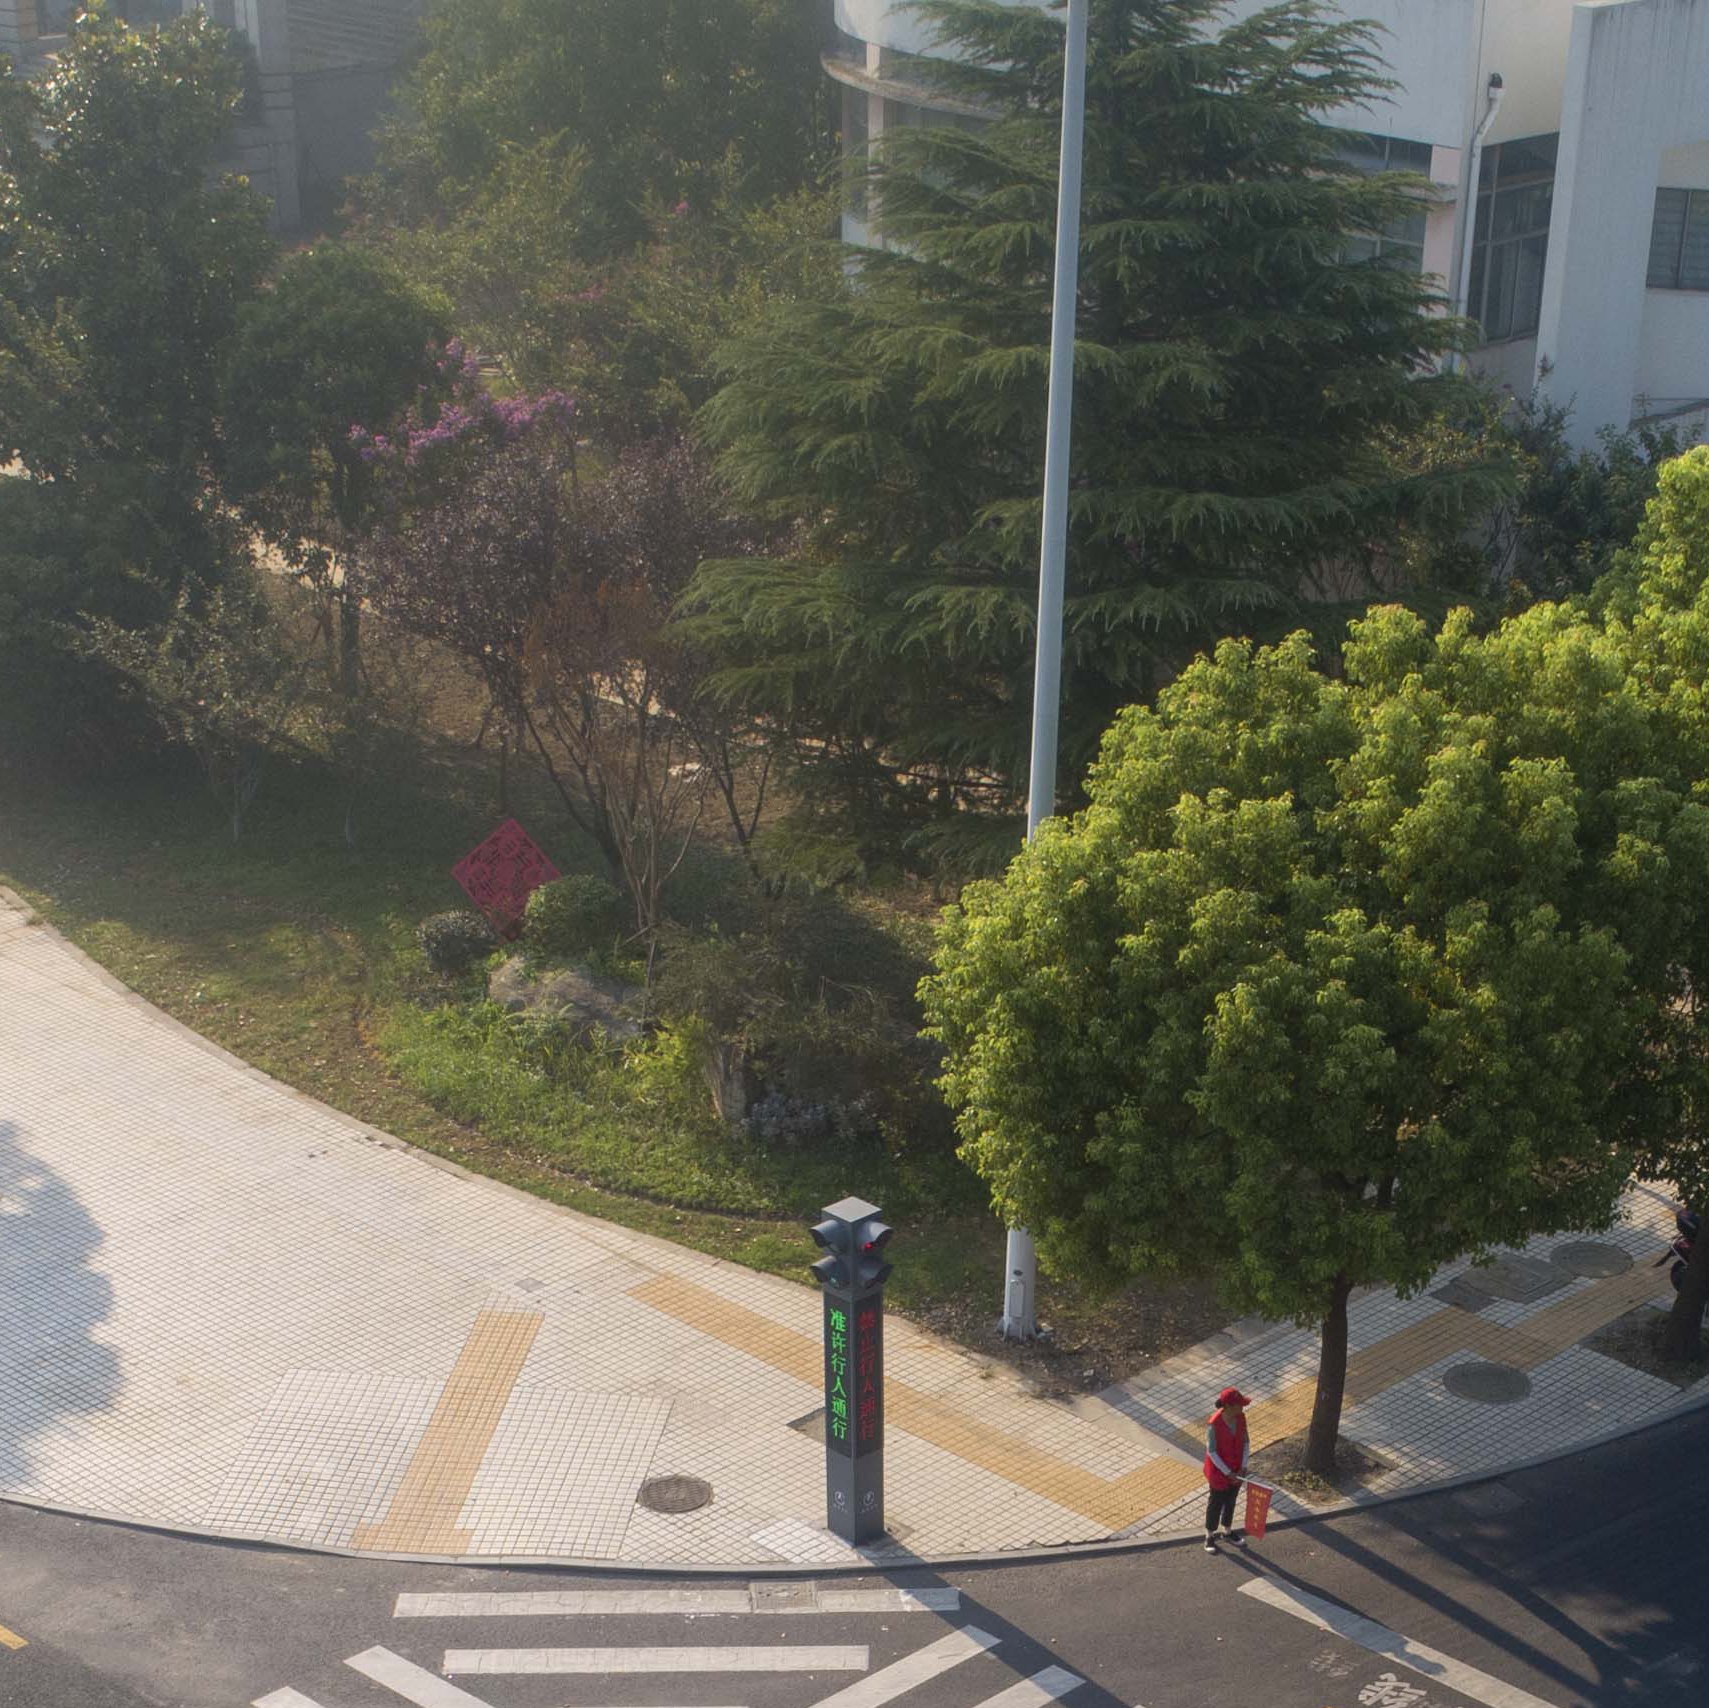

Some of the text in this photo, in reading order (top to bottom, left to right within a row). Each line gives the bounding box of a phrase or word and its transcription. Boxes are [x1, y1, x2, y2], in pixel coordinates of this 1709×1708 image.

[830, 1308, 847, 1440] 准许行人通行
